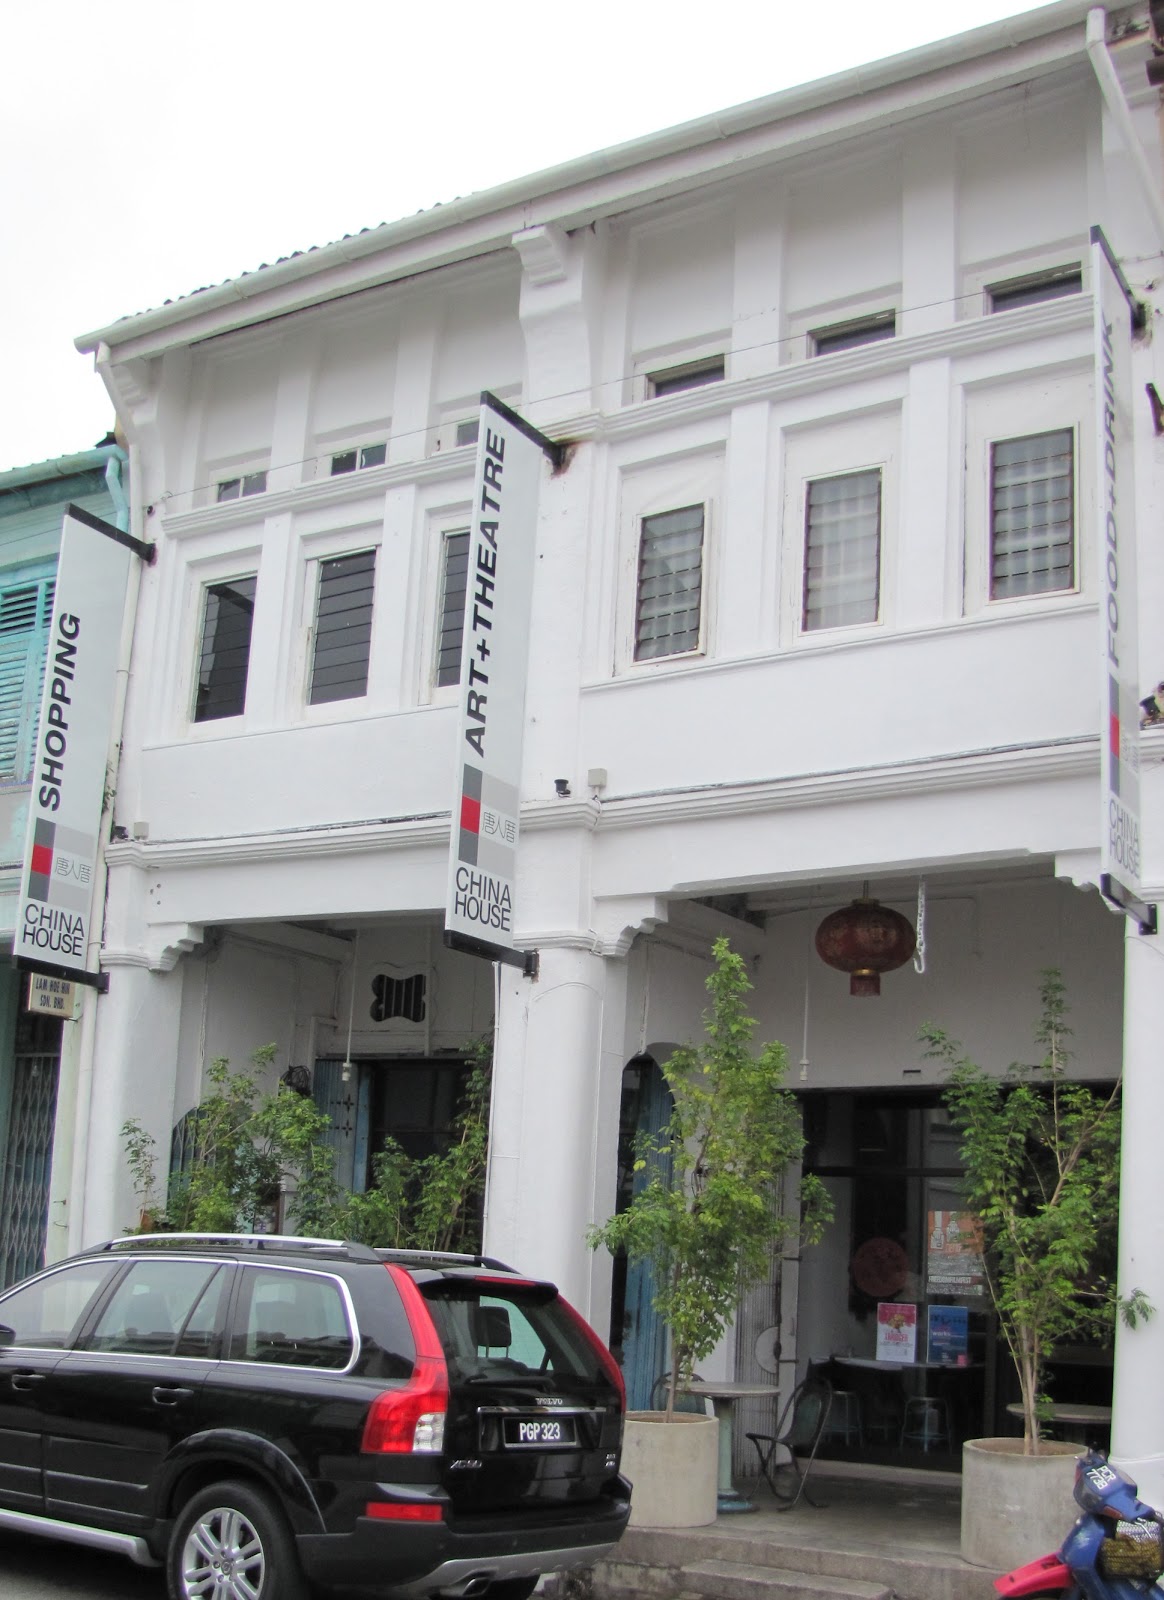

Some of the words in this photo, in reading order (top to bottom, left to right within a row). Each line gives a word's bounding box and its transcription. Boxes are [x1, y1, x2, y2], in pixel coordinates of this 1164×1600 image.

[465, 427, 506, 759] ART+THEATRE
[38, 612, 80, 812] SHOPPING
[1109, 799, 1139, 851] CHINA
[1109, 827, 1140, 880] HOUSE
[455, 866, 512, 909] CHINA
[25, 903, 85, 937] CHINA
[454, 891, 511, 932] HOUSE
[22, 923, 83, 957] HOUSE
[519, 1422, 541, 1441] PGP
[541, 1422, 561, 1440] 323
[1097, 1465, 1117, 1482] PCR
